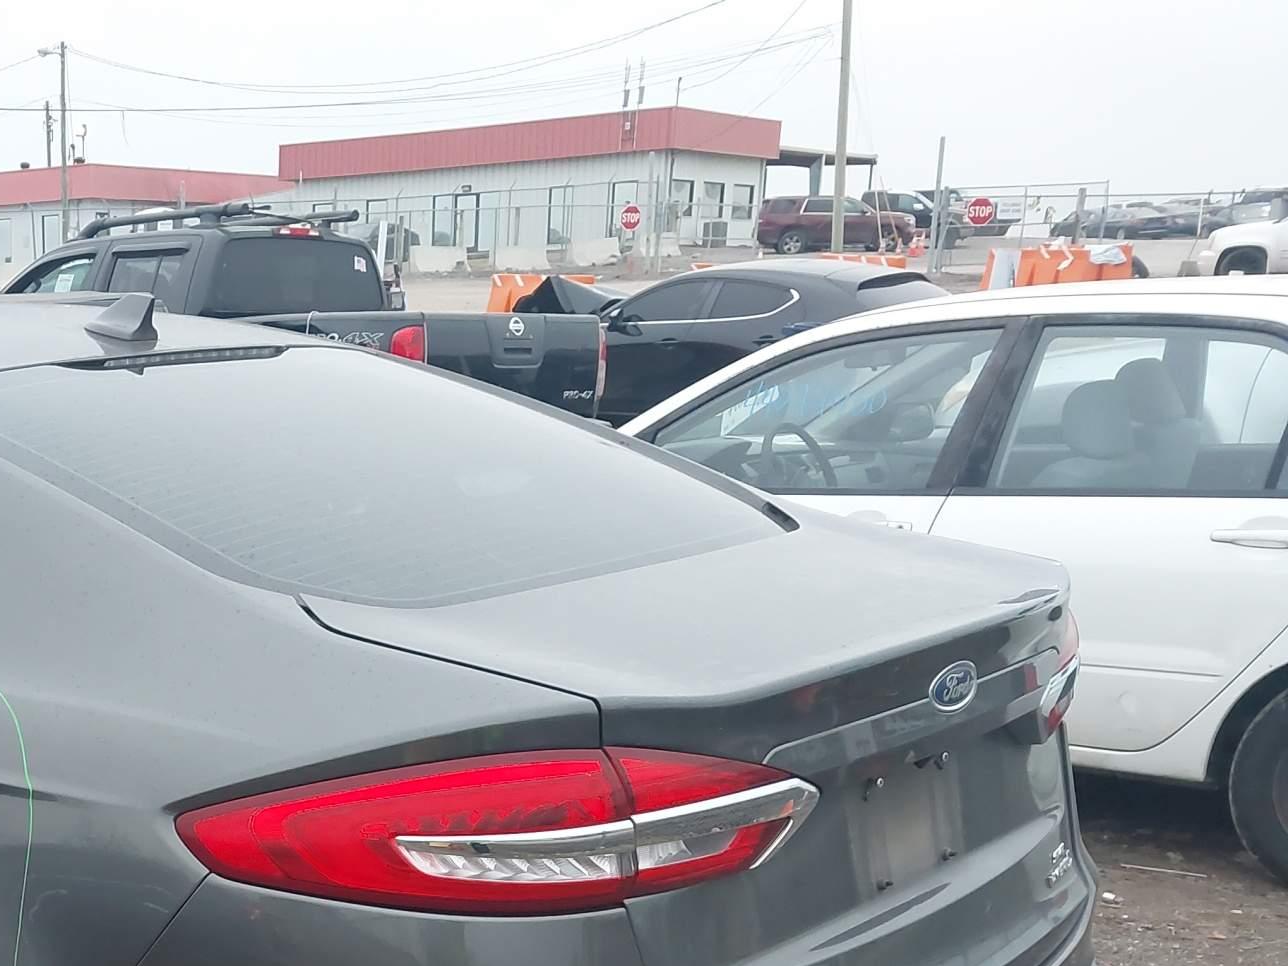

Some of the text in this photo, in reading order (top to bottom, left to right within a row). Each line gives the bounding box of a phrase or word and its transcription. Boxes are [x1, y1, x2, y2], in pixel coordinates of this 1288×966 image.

[969, 206, 992, 217] STOP
[622, 212, 640, 223] STOP
[943, 671, 970, 702] Ford
